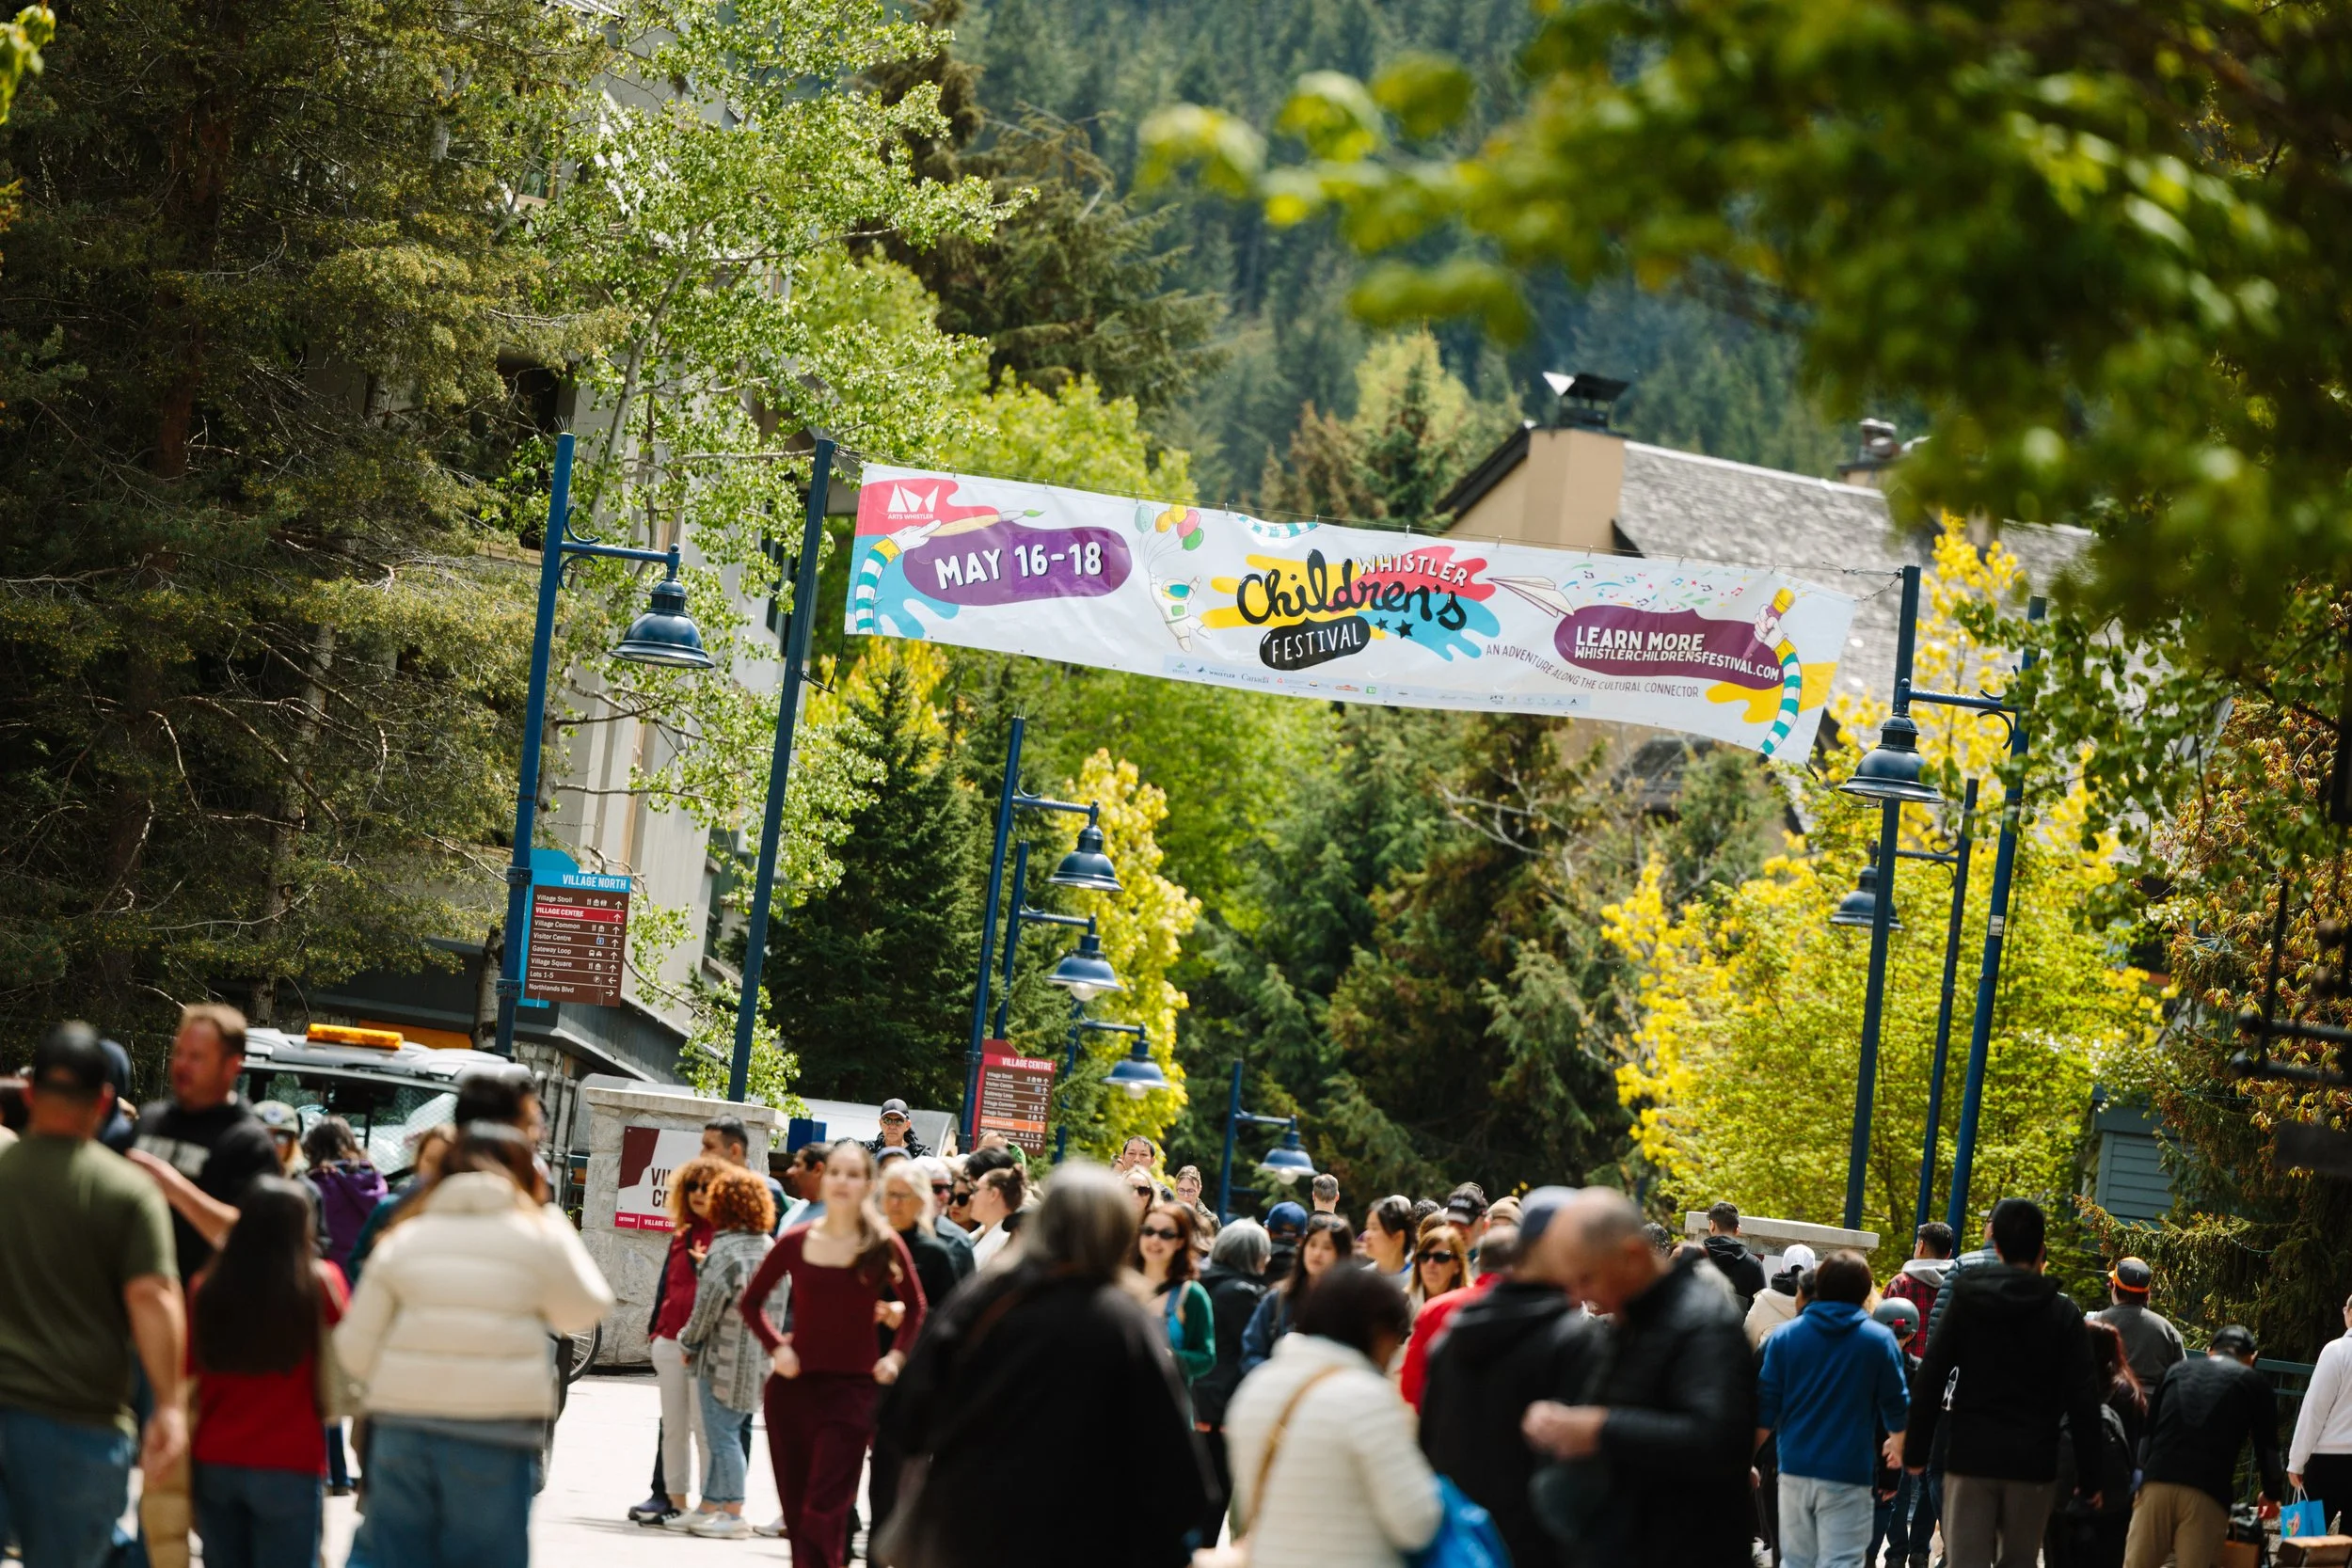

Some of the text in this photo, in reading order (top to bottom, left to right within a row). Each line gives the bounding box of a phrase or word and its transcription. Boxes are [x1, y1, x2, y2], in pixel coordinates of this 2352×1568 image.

[934, 541, 1103, 590] MAY 16-18
[1356, 553, 1468, 587] WHISTLER
[1236, 548, 1468, 631] Children's
[1271, 622, 1361, 663] FESTIVAL
[1575, 626, 1705, 652] LEARN MORE
[1574, 646, 1780, 681] WHISTLERCHILDRENSFESTIVAL.COM
[1209, 670, 1236, 679] WHISTLER
[1486, 643, 1699, 698] AN ADVENTURE ALONG THE CULTURAL CONNECTOR
[1241, 673, 1270, 684] Canada
[563, 874, 627, 890] VILLAGE NORTH
[536, 895, 556, 903] Village
[535, 907, 584, 917] VILLAGE CENTRE
[534, 920, 580, 929] Village Common
[532, 945, 556, 955] Gateway
[531, 958, 572, 968] Village Square
[529, 983, 560, 992] Northlands
[1002, 1057, 1052, 1070] VILLAGE CENTRE
[987, 1071, 1001, 1080] Village
